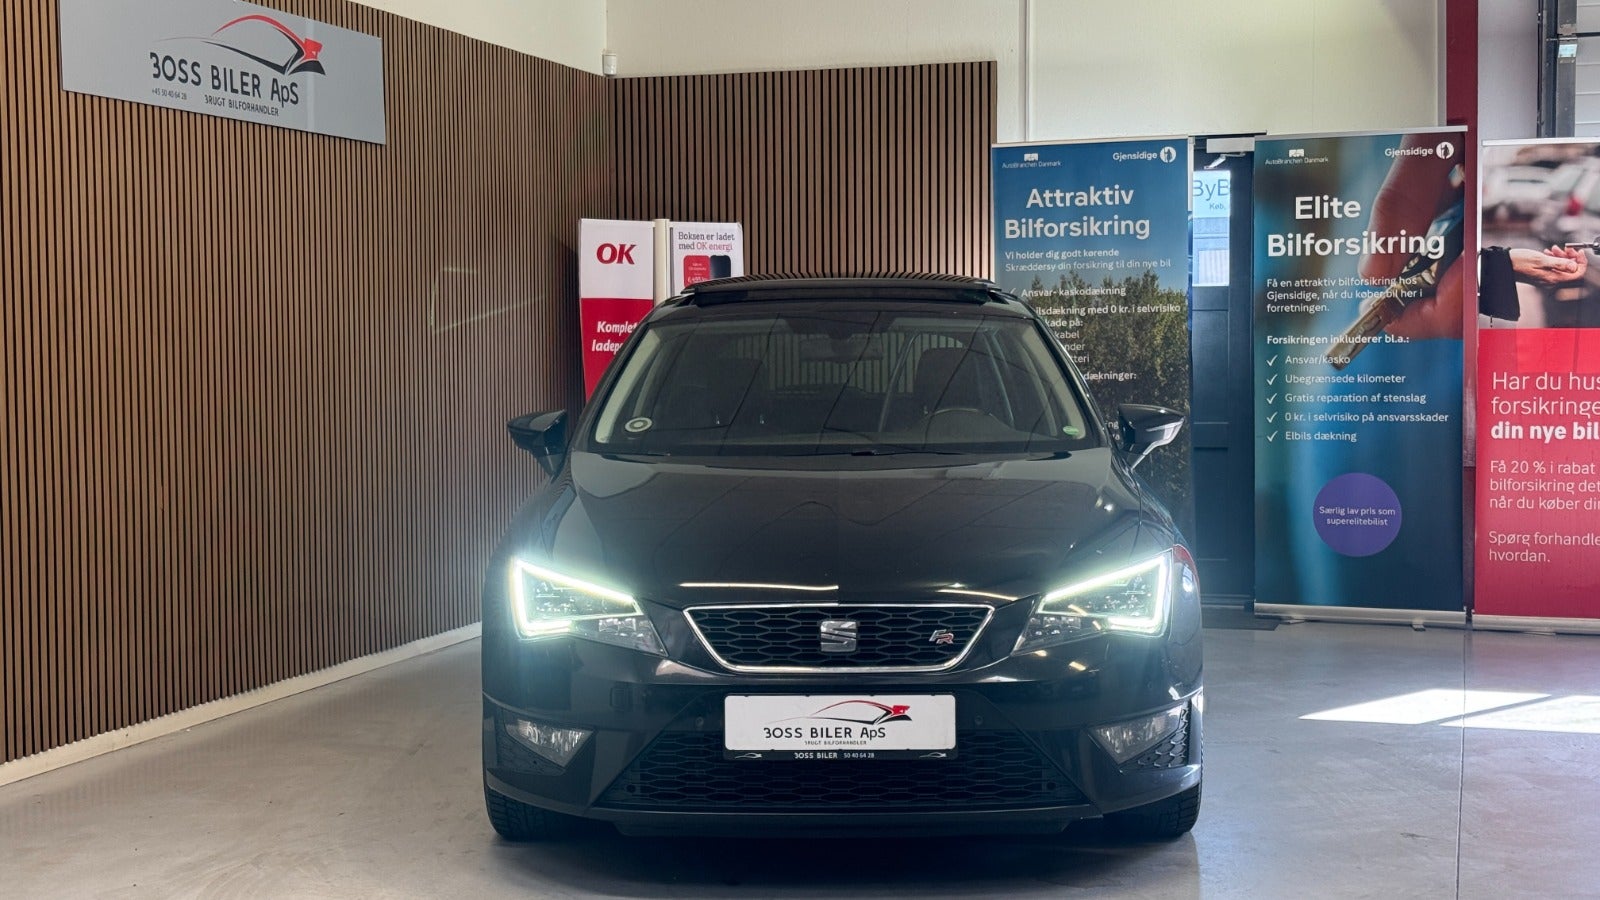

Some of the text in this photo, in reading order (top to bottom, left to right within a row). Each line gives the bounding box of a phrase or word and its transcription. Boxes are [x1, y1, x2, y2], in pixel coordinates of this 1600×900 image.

[210, 64, 262, 98] BILER
[270, 78, 299, 112] ApS
[228, 99, 279, 116] BILFORHANDLER
[1112, 150, 1158, 162] Gjensidige
[1385, 147, 1433, 158] Gjensidige
[1265, 157, 1303, 165] AutoBranchen
[1026, 184, 1134, 208] Attraktiv
[1296, 195, 1361, 220] Elite
[1004, 214, 1150, 240] Bilforsikring
[678, 232, 704, 240] Boksen
[709, 243, 733, 252] energi
[1268, 230, 1444, 260] Bilforsikring
[596, 243, 636, 265] OK
[1016, 251, 1044, 259] holder
[1046, 250, 1059, 261] dig
[1061, 250, 1081, 260] godt
[1083, 249, 1120, 258] kørende
[1005, 259, 1171, 274] Skræddersy din forsikring til din nye bil
[1267, 277, 1278, 287] Få
[1294, 278, 1336, 287] attraktiv
[1338, 277, 1396, 287] bilforsikring
[1399, 277, 1417, 285] hos
[1022, 286, 1126, 297] Ansvar- kaskodækning
[1267, 291, 1320, 302] Gjensidige,
[1323, 288, 1339, 299] når
[1341, 289, 1353, 298] du
[1355, 289, 1383, 298] køber
[1386, 289, 1397, 298] bil
[1401, 289, 1417, 298] her
[1036, 306, 1086, 316] ilsdækning
[1088, 306, 1108, 314] med
[1120, 305, 1131, 313] kr.
[1137, 304, 1181, 313] selvrisiko
[1267, 303, 1329, 313] forretningen.
[1045, 318, 1084, 328] kade på:
[1055, 331, 1080, 339] kabel
[1267, 334, 1409, 346] Forsikringen inkluderer bl.a.:
[1285, 355, 1350, 365] Ansvar/kasko
[1285, 374, 1406, 384] Ubegrænsede kilometer
[1492, 372, 1530, 390] Har
[1536, 372, 1562, 390] du
[1285, 393, 1426, 404] Gratis reparation af stenslag
[1491, 396, 1600, 418] forsikringe
[1285, 412, 1291, 421] 0
[1294, 412, 1306, 421] kr.
[1313, 412, 1359, 421] selvrisiko
[1362, 411, 1374, 424] på
[1377, 412, 1449, 422] ansvarsskader
[1285, 431, 1357, 442] Elbils dækning
[1491, 422, 1600, 443] din nye bil
[1490, 460, 1595, 474] Få 20 % i rabat
[1490, 478, 1575, 494] bilforsikring
[1490, 495, 1513, 508] når
[1516, 497, 1534, 509] du
[1539, 497, 1578, 510] køber
[1319, 506, 1345, 516] Særlig
[1347, 507, 1359, 515] lav
[1360, 507, 1376, 516] pris
[1327, 517, 1388, 526] superelitebilist
[1488, 531, 1530, 547] Spørg
[1489, 549, 1550, 562] hvordan.
[928, 629, 954, 644] FR
[811, 727, 852, 738] BILER
[860, 727, 886, 740] ApS
